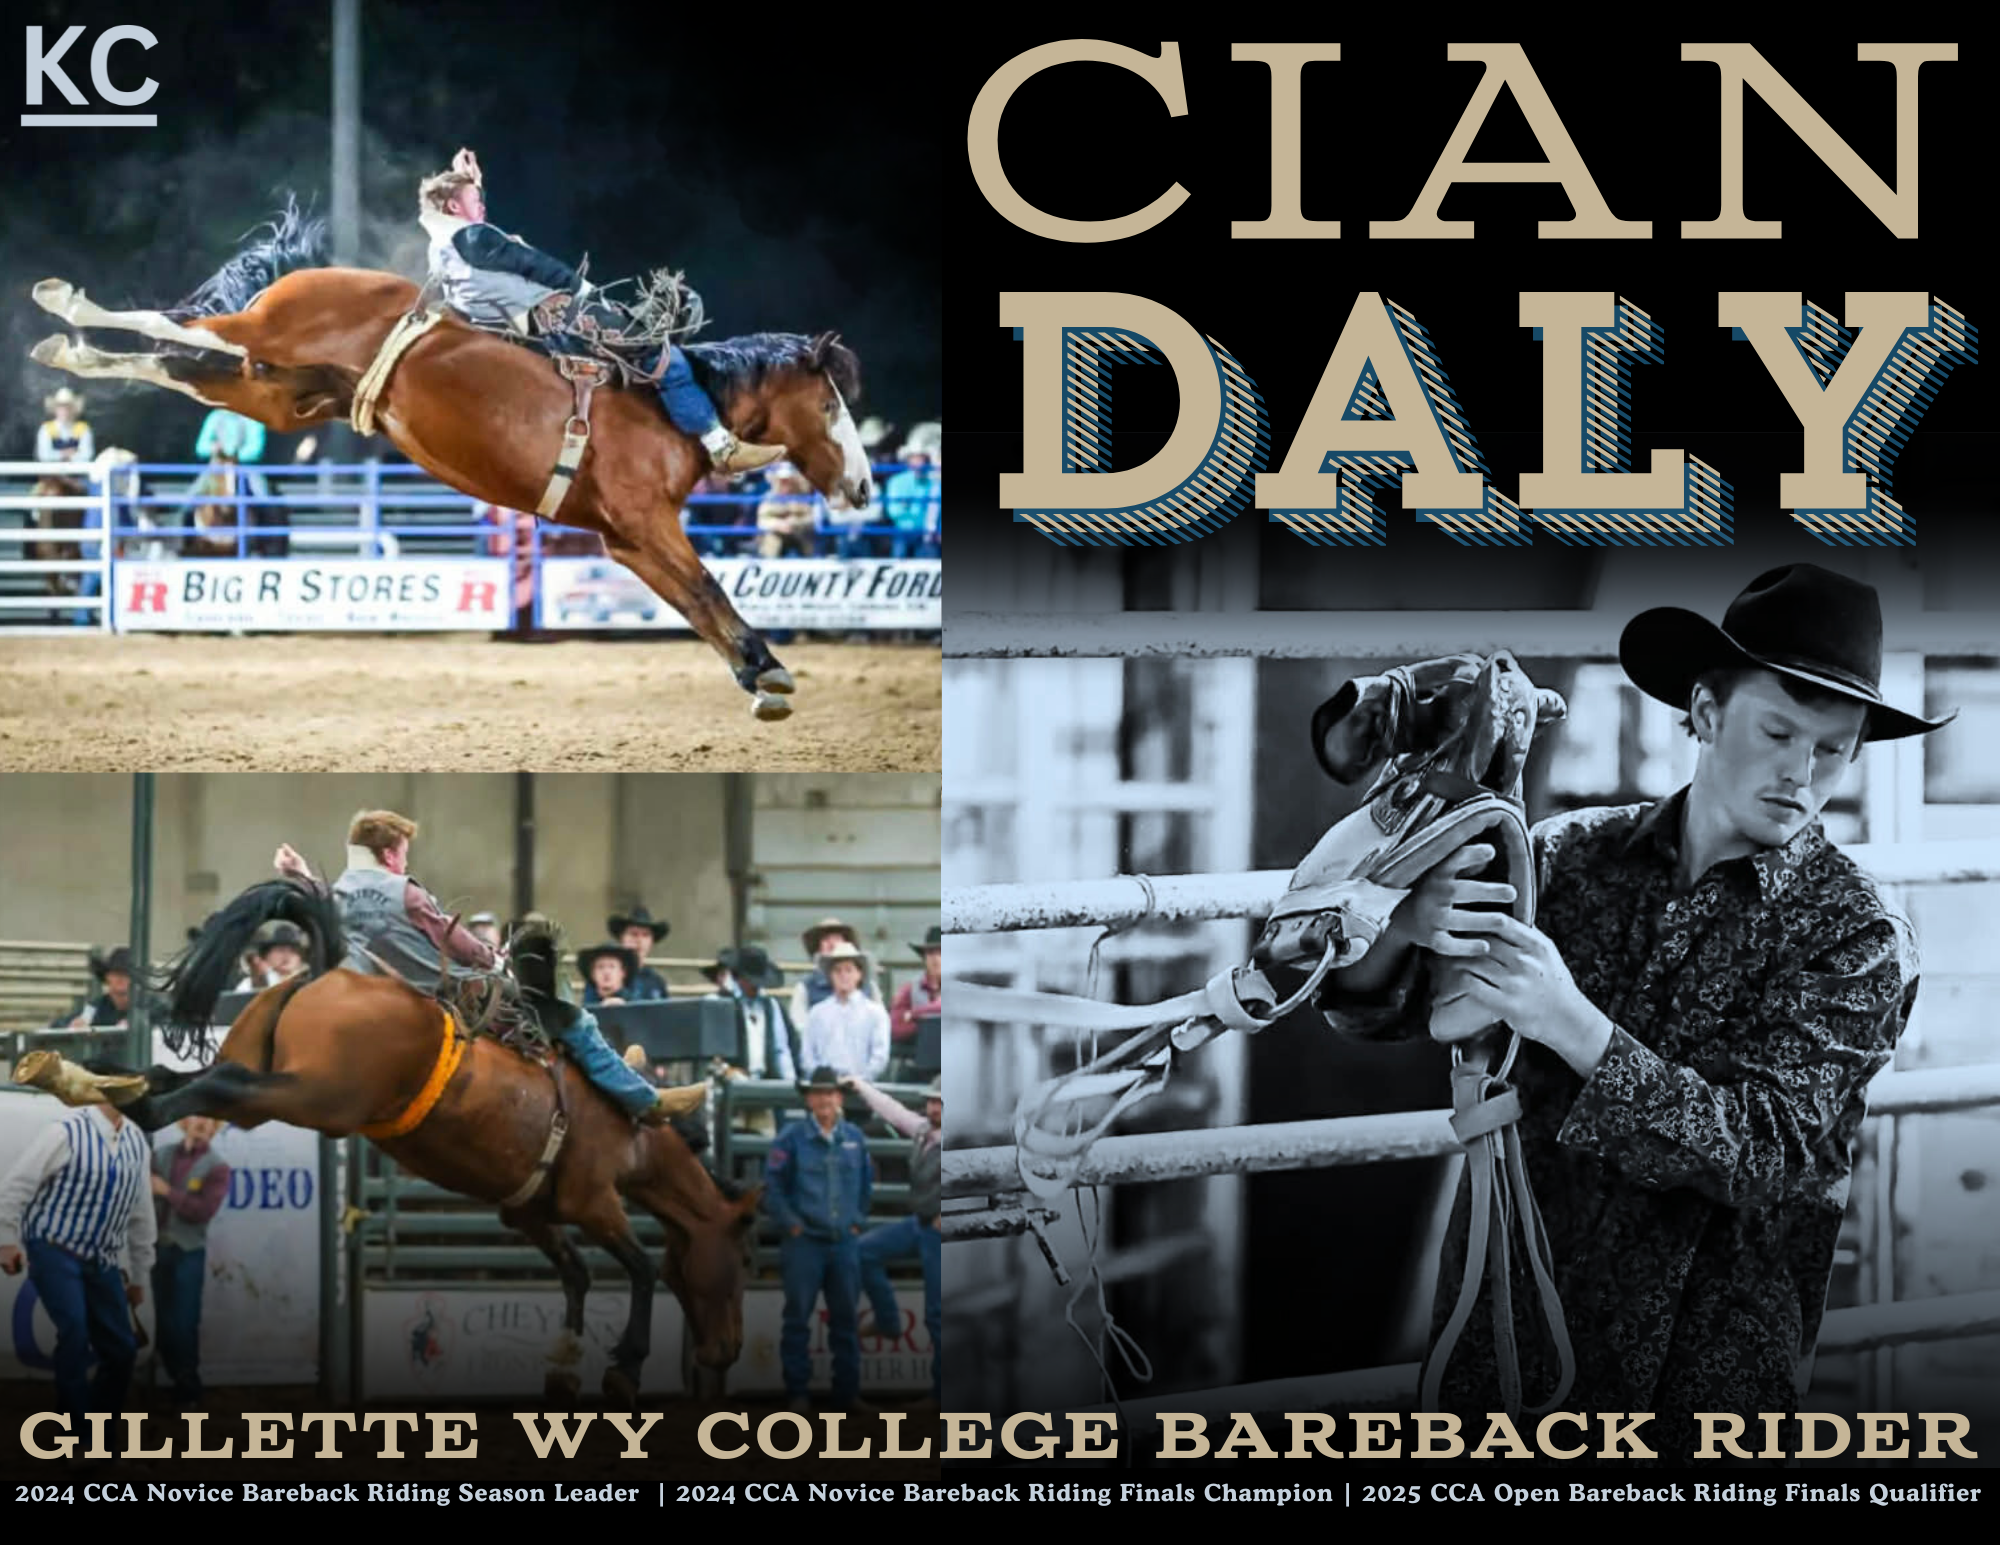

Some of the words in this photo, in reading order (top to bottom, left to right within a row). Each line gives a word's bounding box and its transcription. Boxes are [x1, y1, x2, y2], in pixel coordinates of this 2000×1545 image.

[183, 570, 242, 603] BIG
[258, 570, 282, 603] R
[300, 569, 441, 603] STORES
[734, 564, 863, 598] COUNTY
[227, 1167, 314, 1210] DEO
